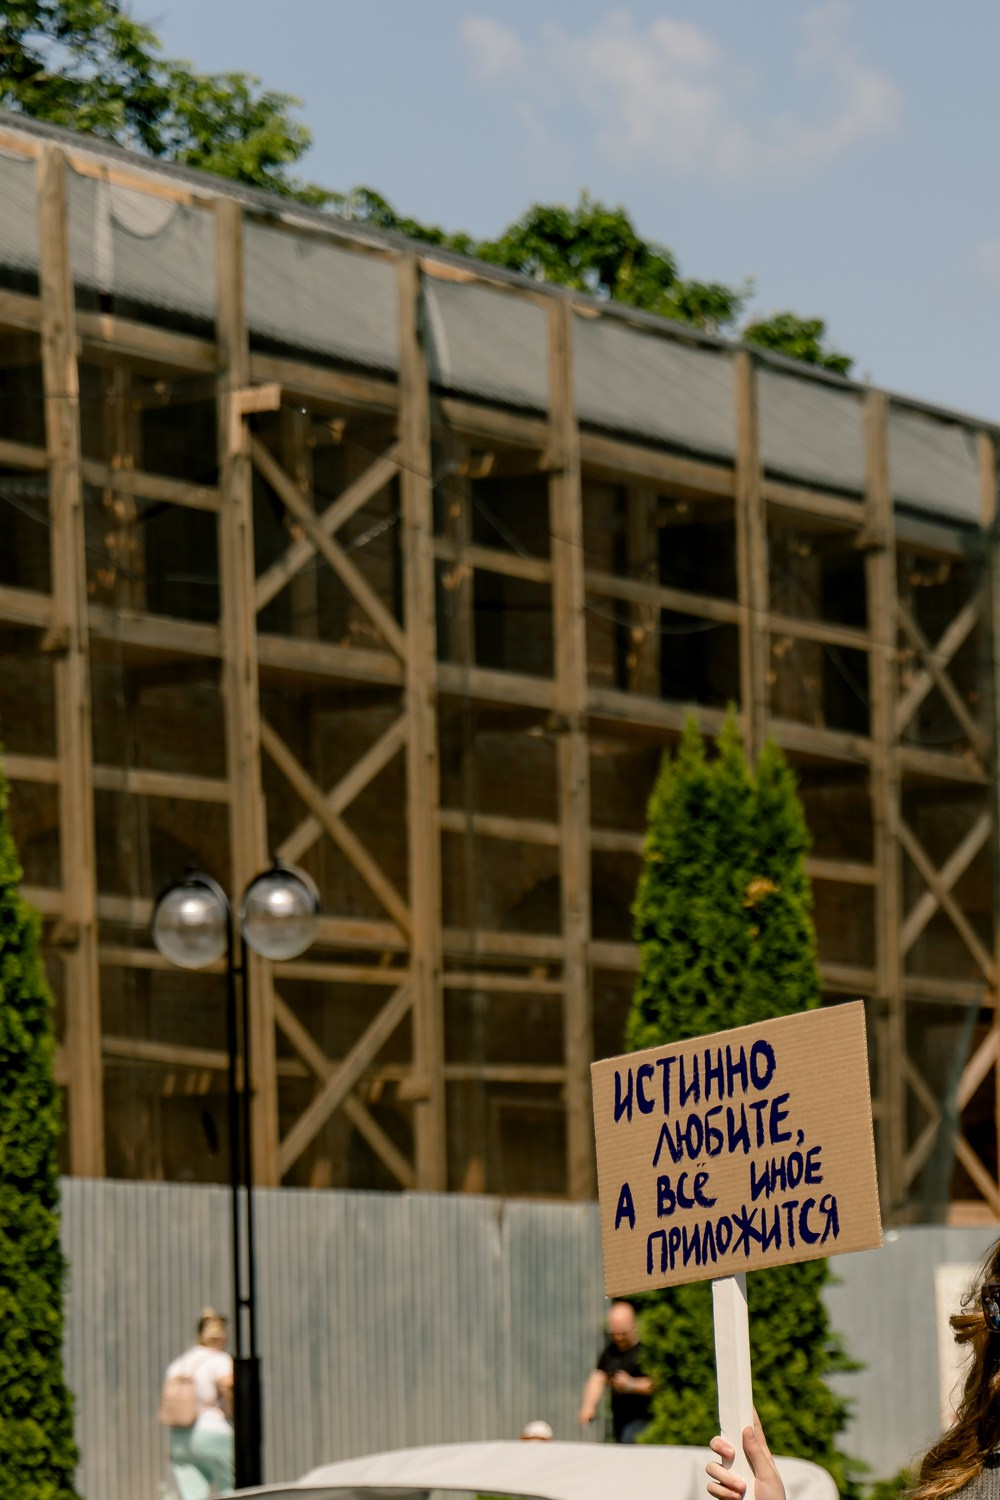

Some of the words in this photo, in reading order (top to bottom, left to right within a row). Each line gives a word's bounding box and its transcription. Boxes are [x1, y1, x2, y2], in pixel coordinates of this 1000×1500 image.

[613, 1039, 777, 1124] ИСТИННО
[652, 1092, 805, 1168] ЛЮБИТЕ,
[614, 1182, 637, 1231] А
[750, 1145, 825, 1202] ИНОЕ
[646, 1193, 840, 1275] ПРИЛОЖИТСЯ
